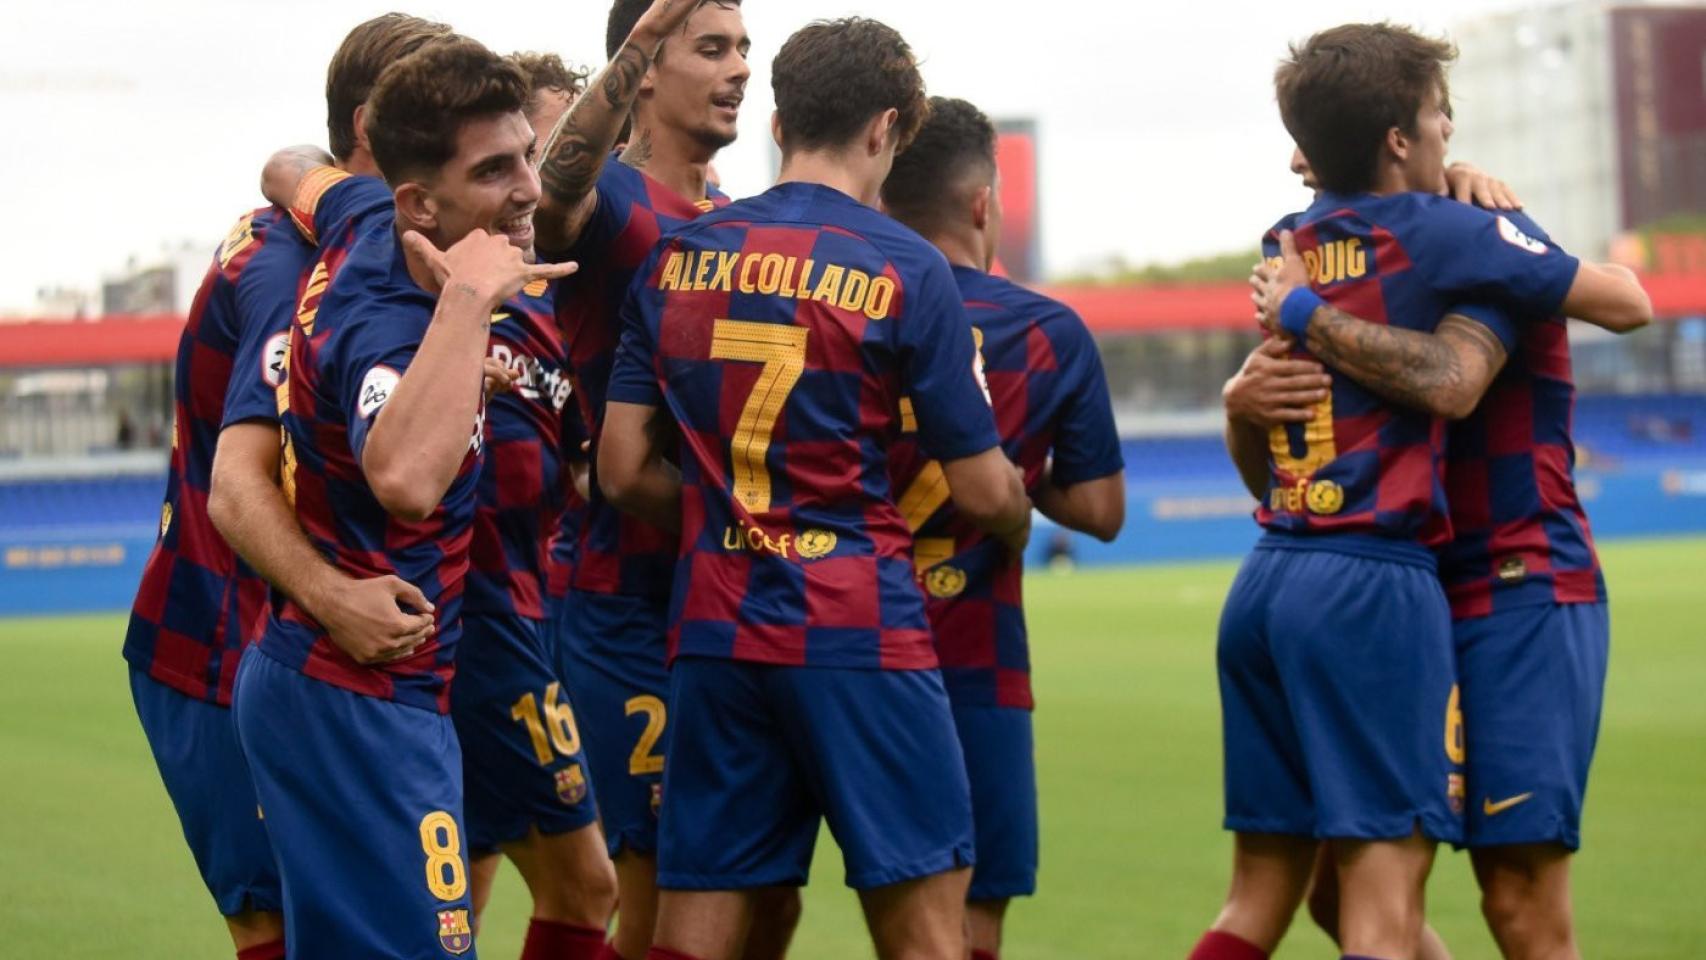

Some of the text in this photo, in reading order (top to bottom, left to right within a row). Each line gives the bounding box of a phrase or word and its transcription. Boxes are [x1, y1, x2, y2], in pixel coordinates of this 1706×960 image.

[658, 250, 896, 321] ALEX COLLADO
[709, 318, 811, 513] 7
[511, 681, 581, 766] 16
[624, 694, 667, 776] 2
[419, 810, 467, 901] 8
